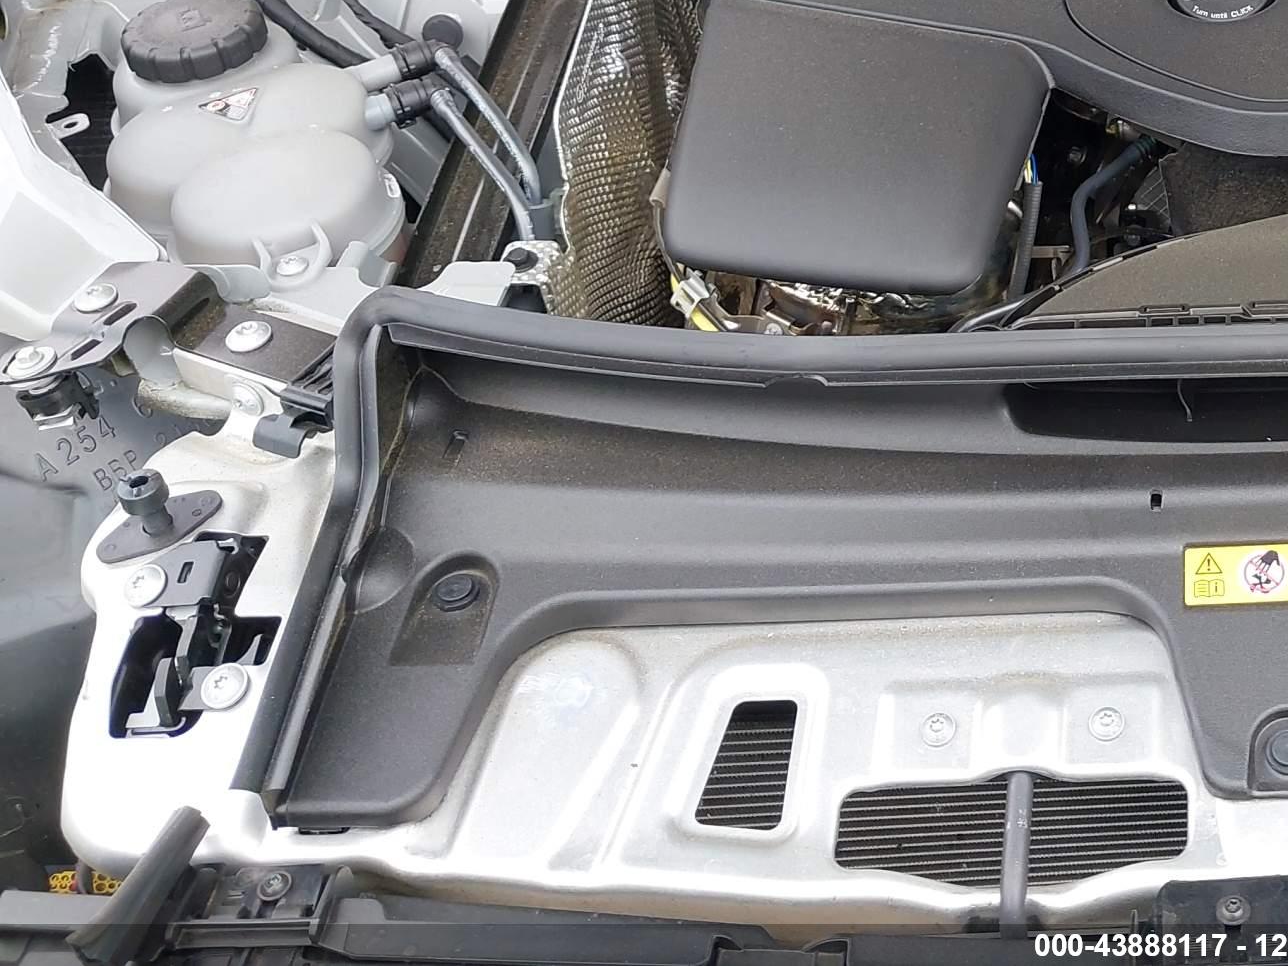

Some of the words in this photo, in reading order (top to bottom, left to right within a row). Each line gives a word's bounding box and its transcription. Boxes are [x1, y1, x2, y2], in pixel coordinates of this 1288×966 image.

[1192, 5, 1209, 17] Turn
[1210, 11, 1228, 19] until
[1230, 5, 1254, 18] CLICK
[34, 452, 59, 483] A
[56, 414, 116, 467] 254
